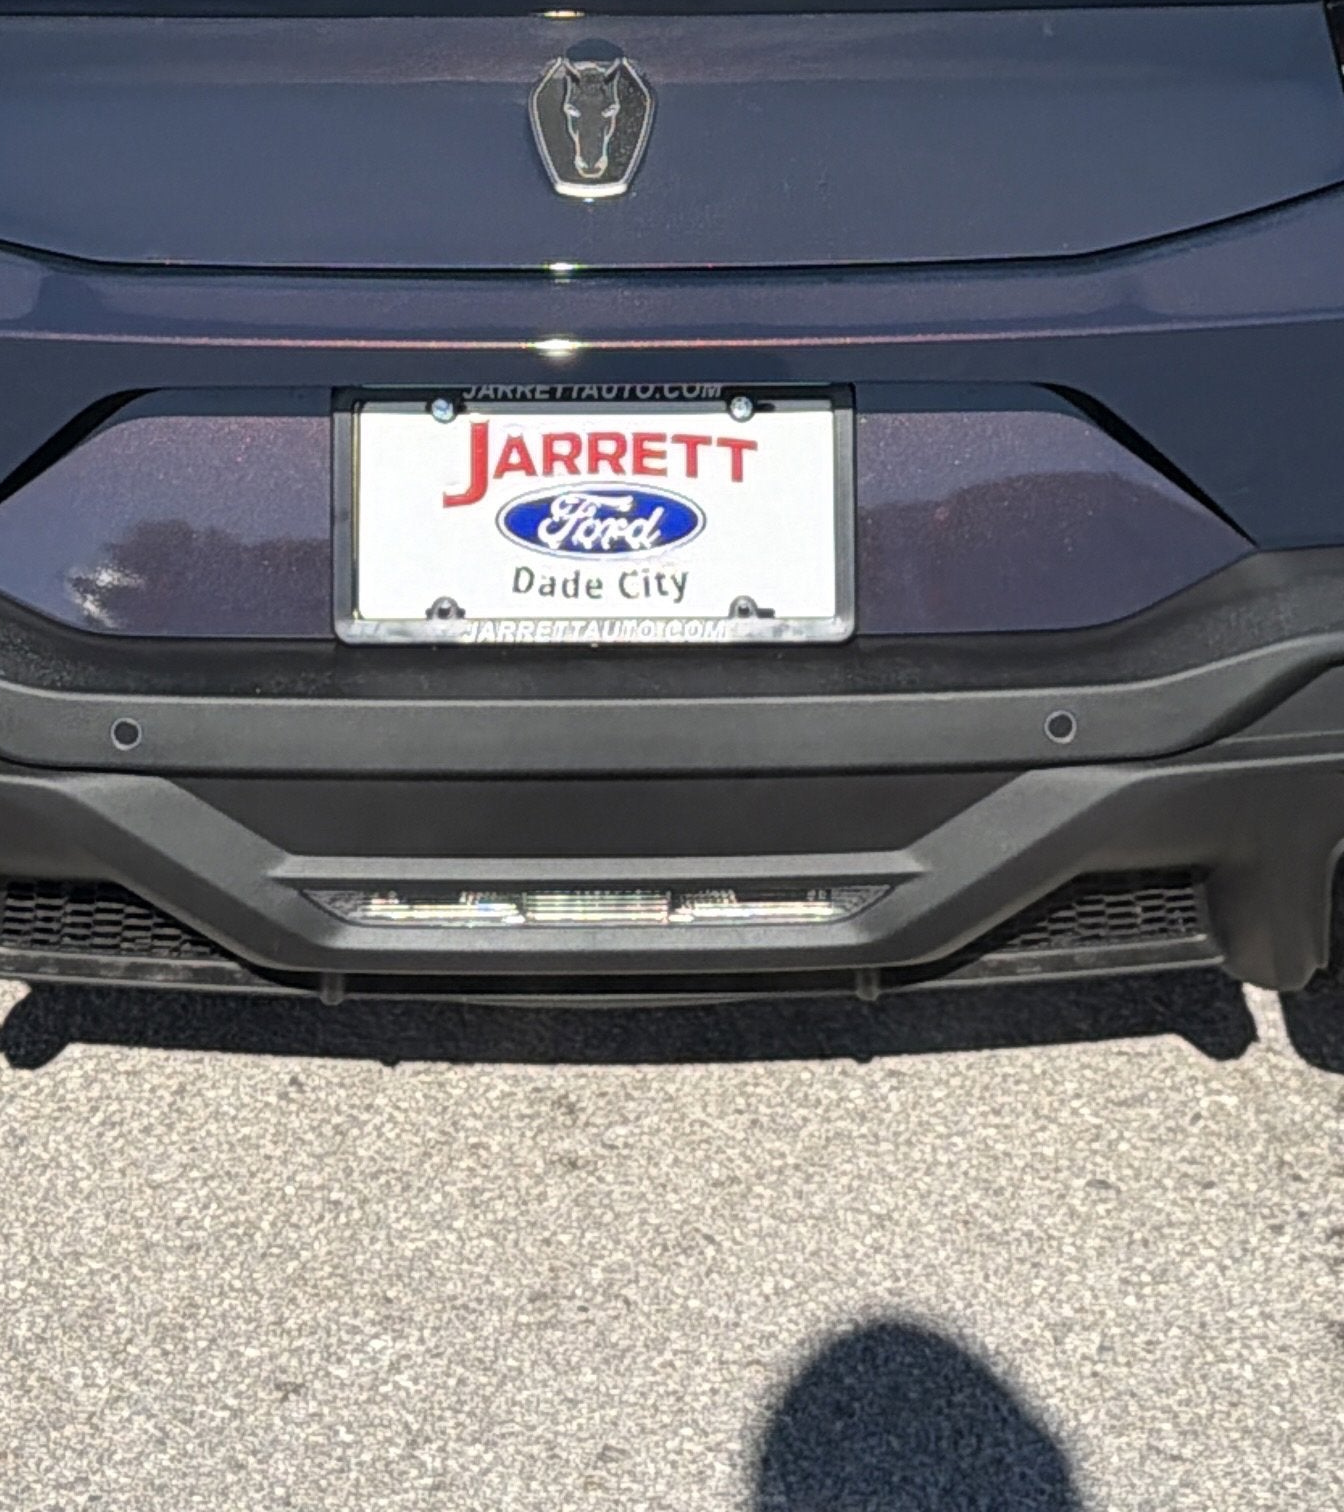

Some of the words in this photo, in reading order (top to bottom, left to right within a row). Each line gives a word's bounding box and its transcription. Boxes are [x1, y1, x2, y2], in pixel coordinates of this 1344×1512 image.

[461, 384, 724, 401] JARRETTAUTO.COM
[442, 420, 759, 509] JARRETT
[537, 489, 663, 551] Ford
[511, 566, 605, 600] Dade
[618, 570, 690, 603] City
[462, 619, 727, 644] JARRETTAUTO.COM
